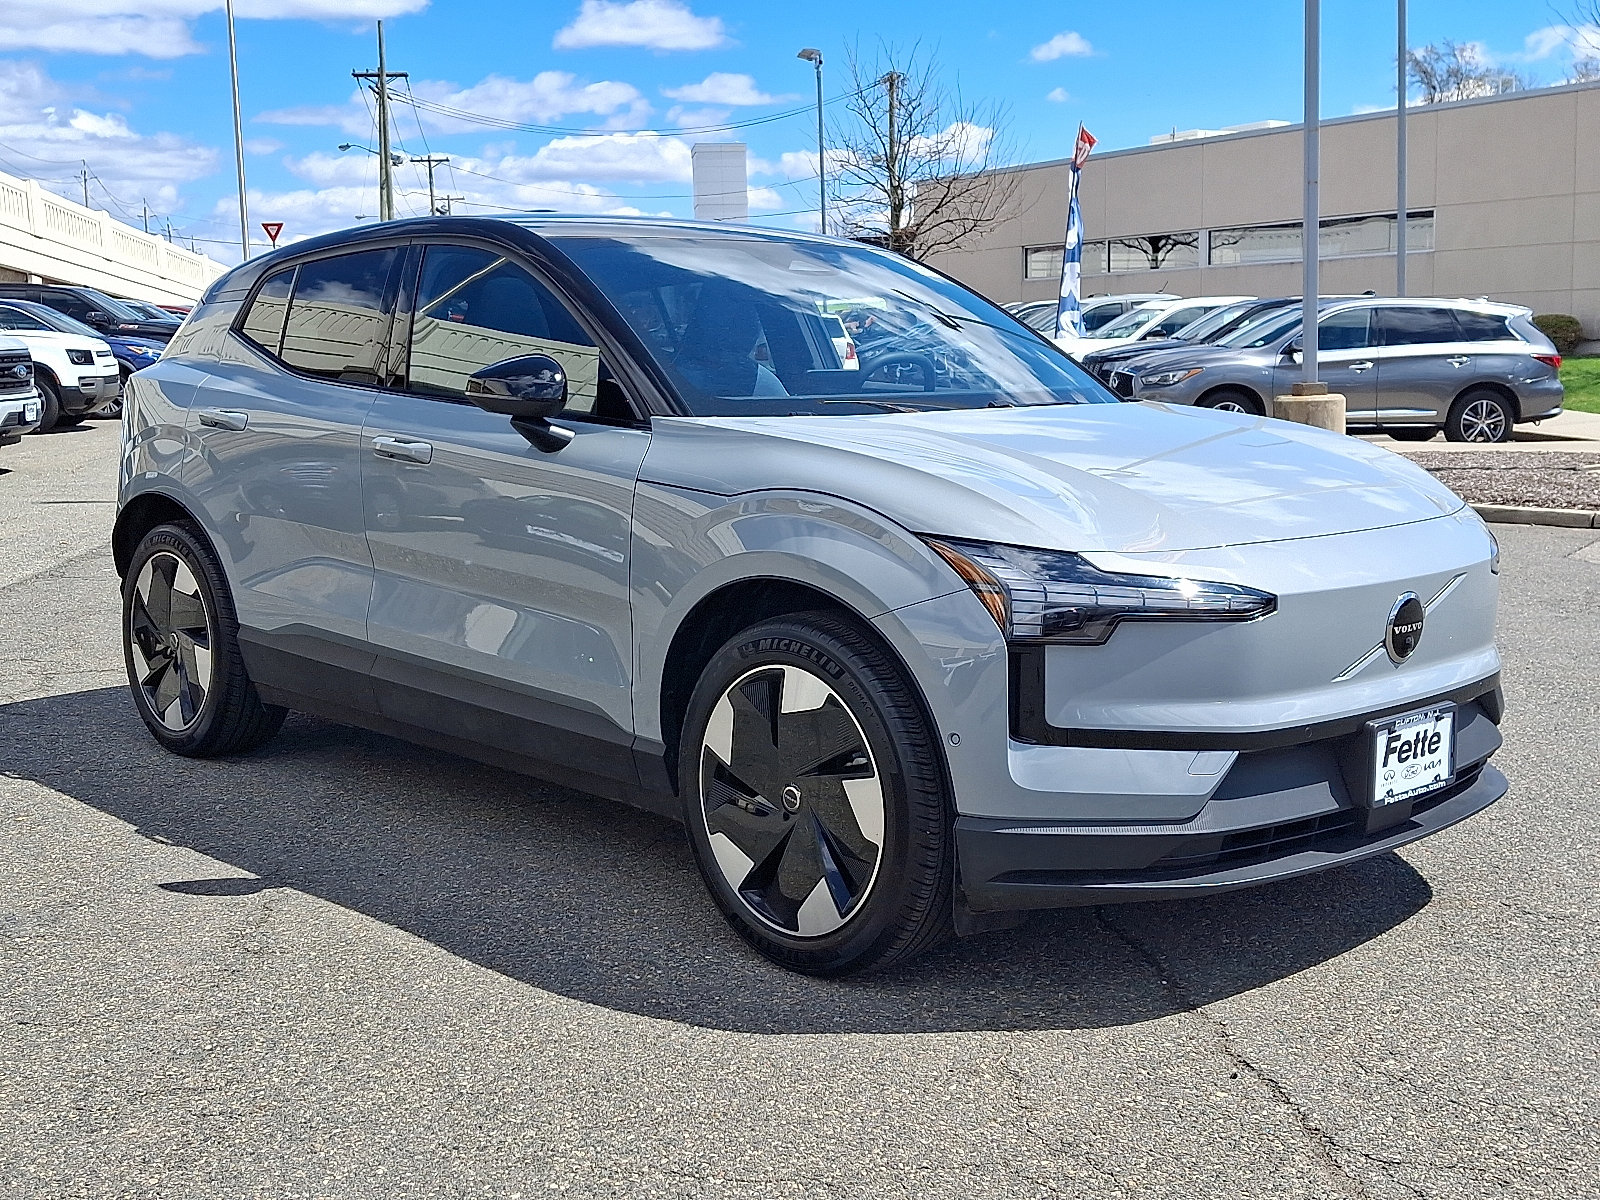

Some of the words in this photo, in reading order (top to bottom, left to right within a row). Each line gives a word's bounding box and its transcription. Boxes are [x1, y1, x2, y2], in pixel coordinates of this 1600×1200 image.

[1394, 622, 1422, 634] VOLVO
[759, 639, 841, 677] MICHELIN
[848, 681, 876, 718] PRIMACY
[1382, 729, 1441, 768] Fette
